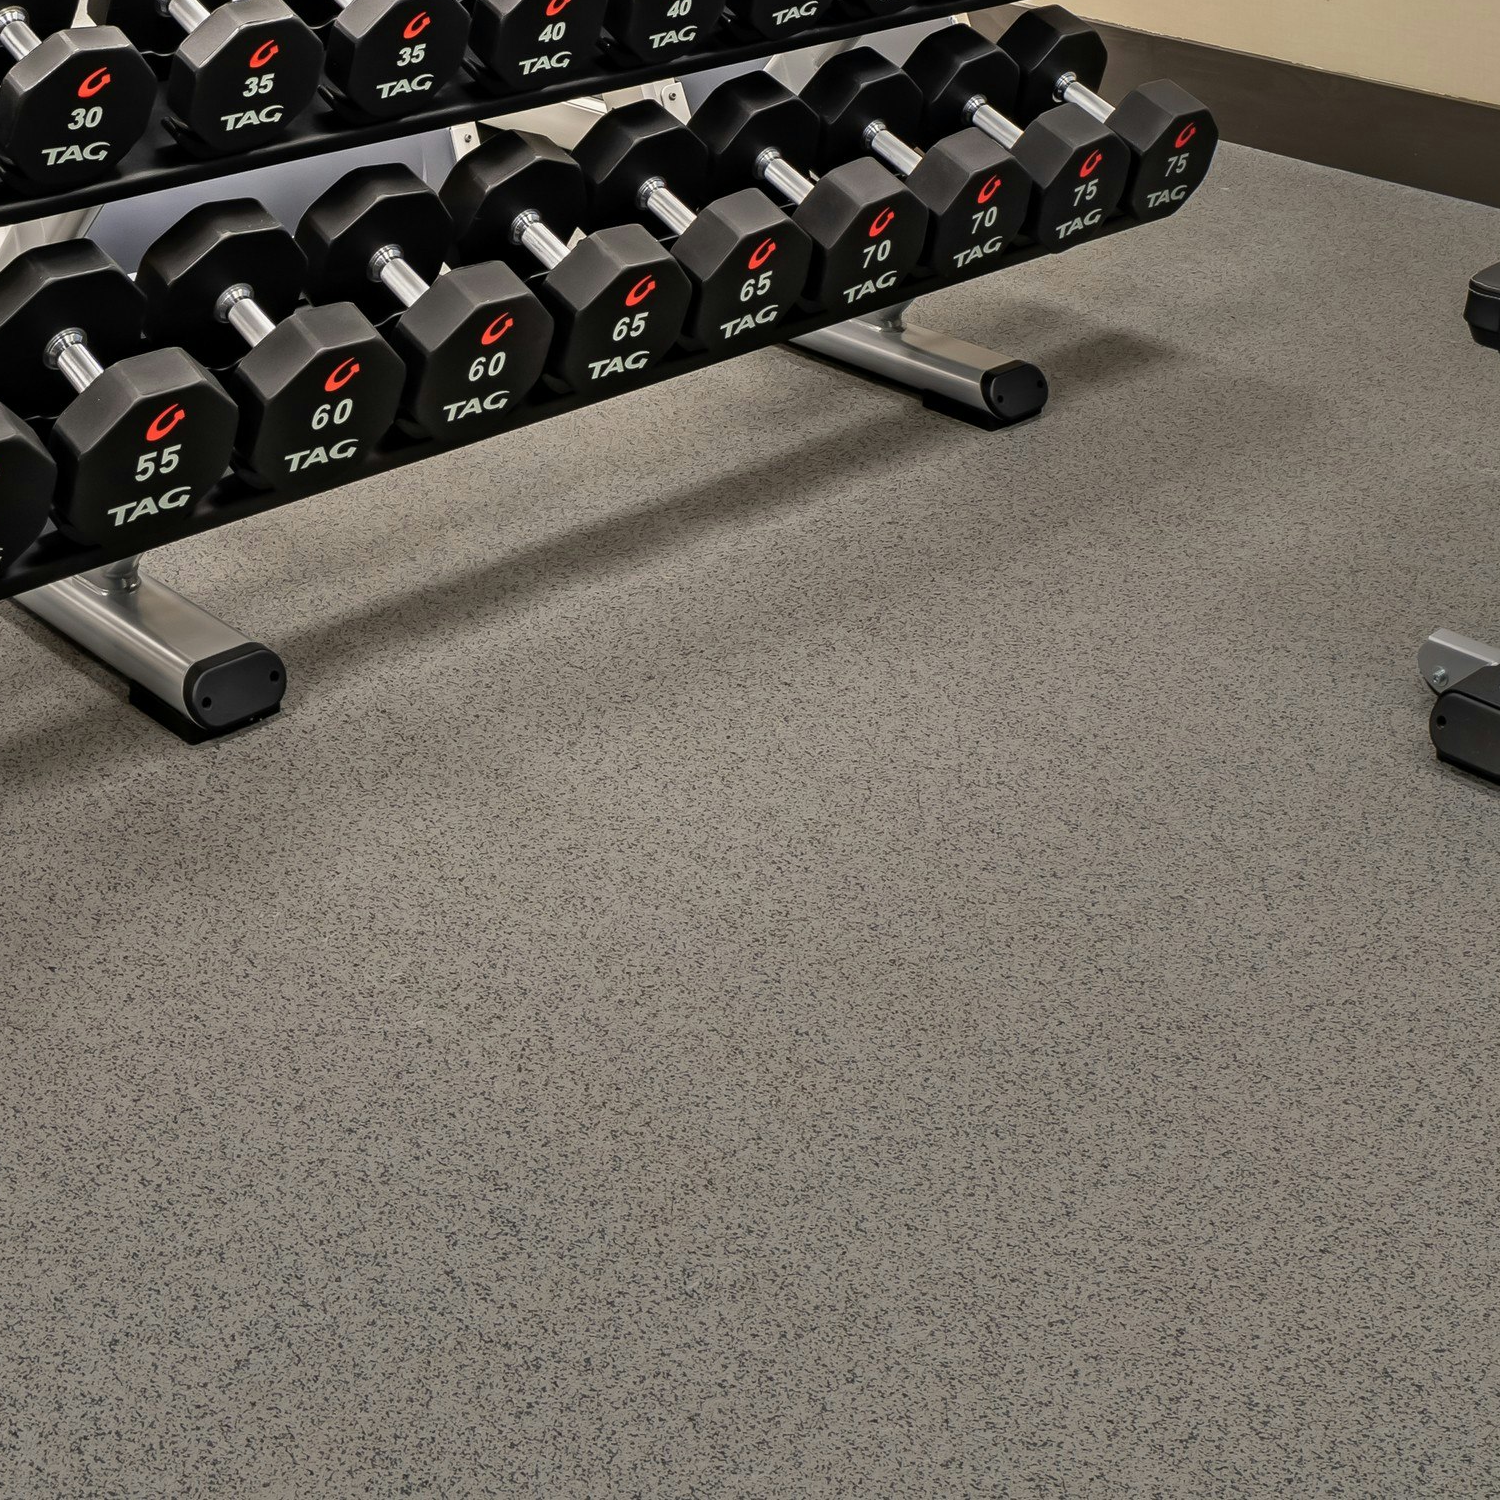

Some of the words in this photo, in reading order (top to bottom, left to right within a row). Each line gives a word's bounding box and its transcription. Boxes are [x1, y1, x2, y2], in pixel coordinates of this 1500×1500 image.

[773, 1, 818, 25] TAG
[539, 22, 565, 42] 40
[649, 26, 697, 48] TAG
[397, 44, 426, 66] 35
[519, 51, 571, 75] TAG
[243, 73, 274, 97] 35
[377, 74, 433, 98] TAG
[68, 107, 102, 129] 30
[221, 105, 283, 130] TAG
[42, 142, 110, 165] TAG
[1165, 153, 1189, 176] 75
[1074, 179, 1098, 206] 75
[1147, 185, 1189, 209] TAG
[972, 207, 997, 234] 70
[1056, 209, 1102, 239] TAG
[863, 240, 890, 268] 70
[954, 236, 1002, 267] TAG
[740, 271, 772, 301] 65
[843, 271, 897, 303] TAG
[613, 312, 648, 341] 65
[720, 305, 778, 338] TAG
[469, 352, 505, 381] 60
[588, 351, 649, 379] TAG
[312, 399, 352, 429] 60
[443, 391, 509, 421] TAG
[135, 444, 181, 481] 55
[285, 439, 358, 472] TAG
[108, 487, 191, 526] TAG
